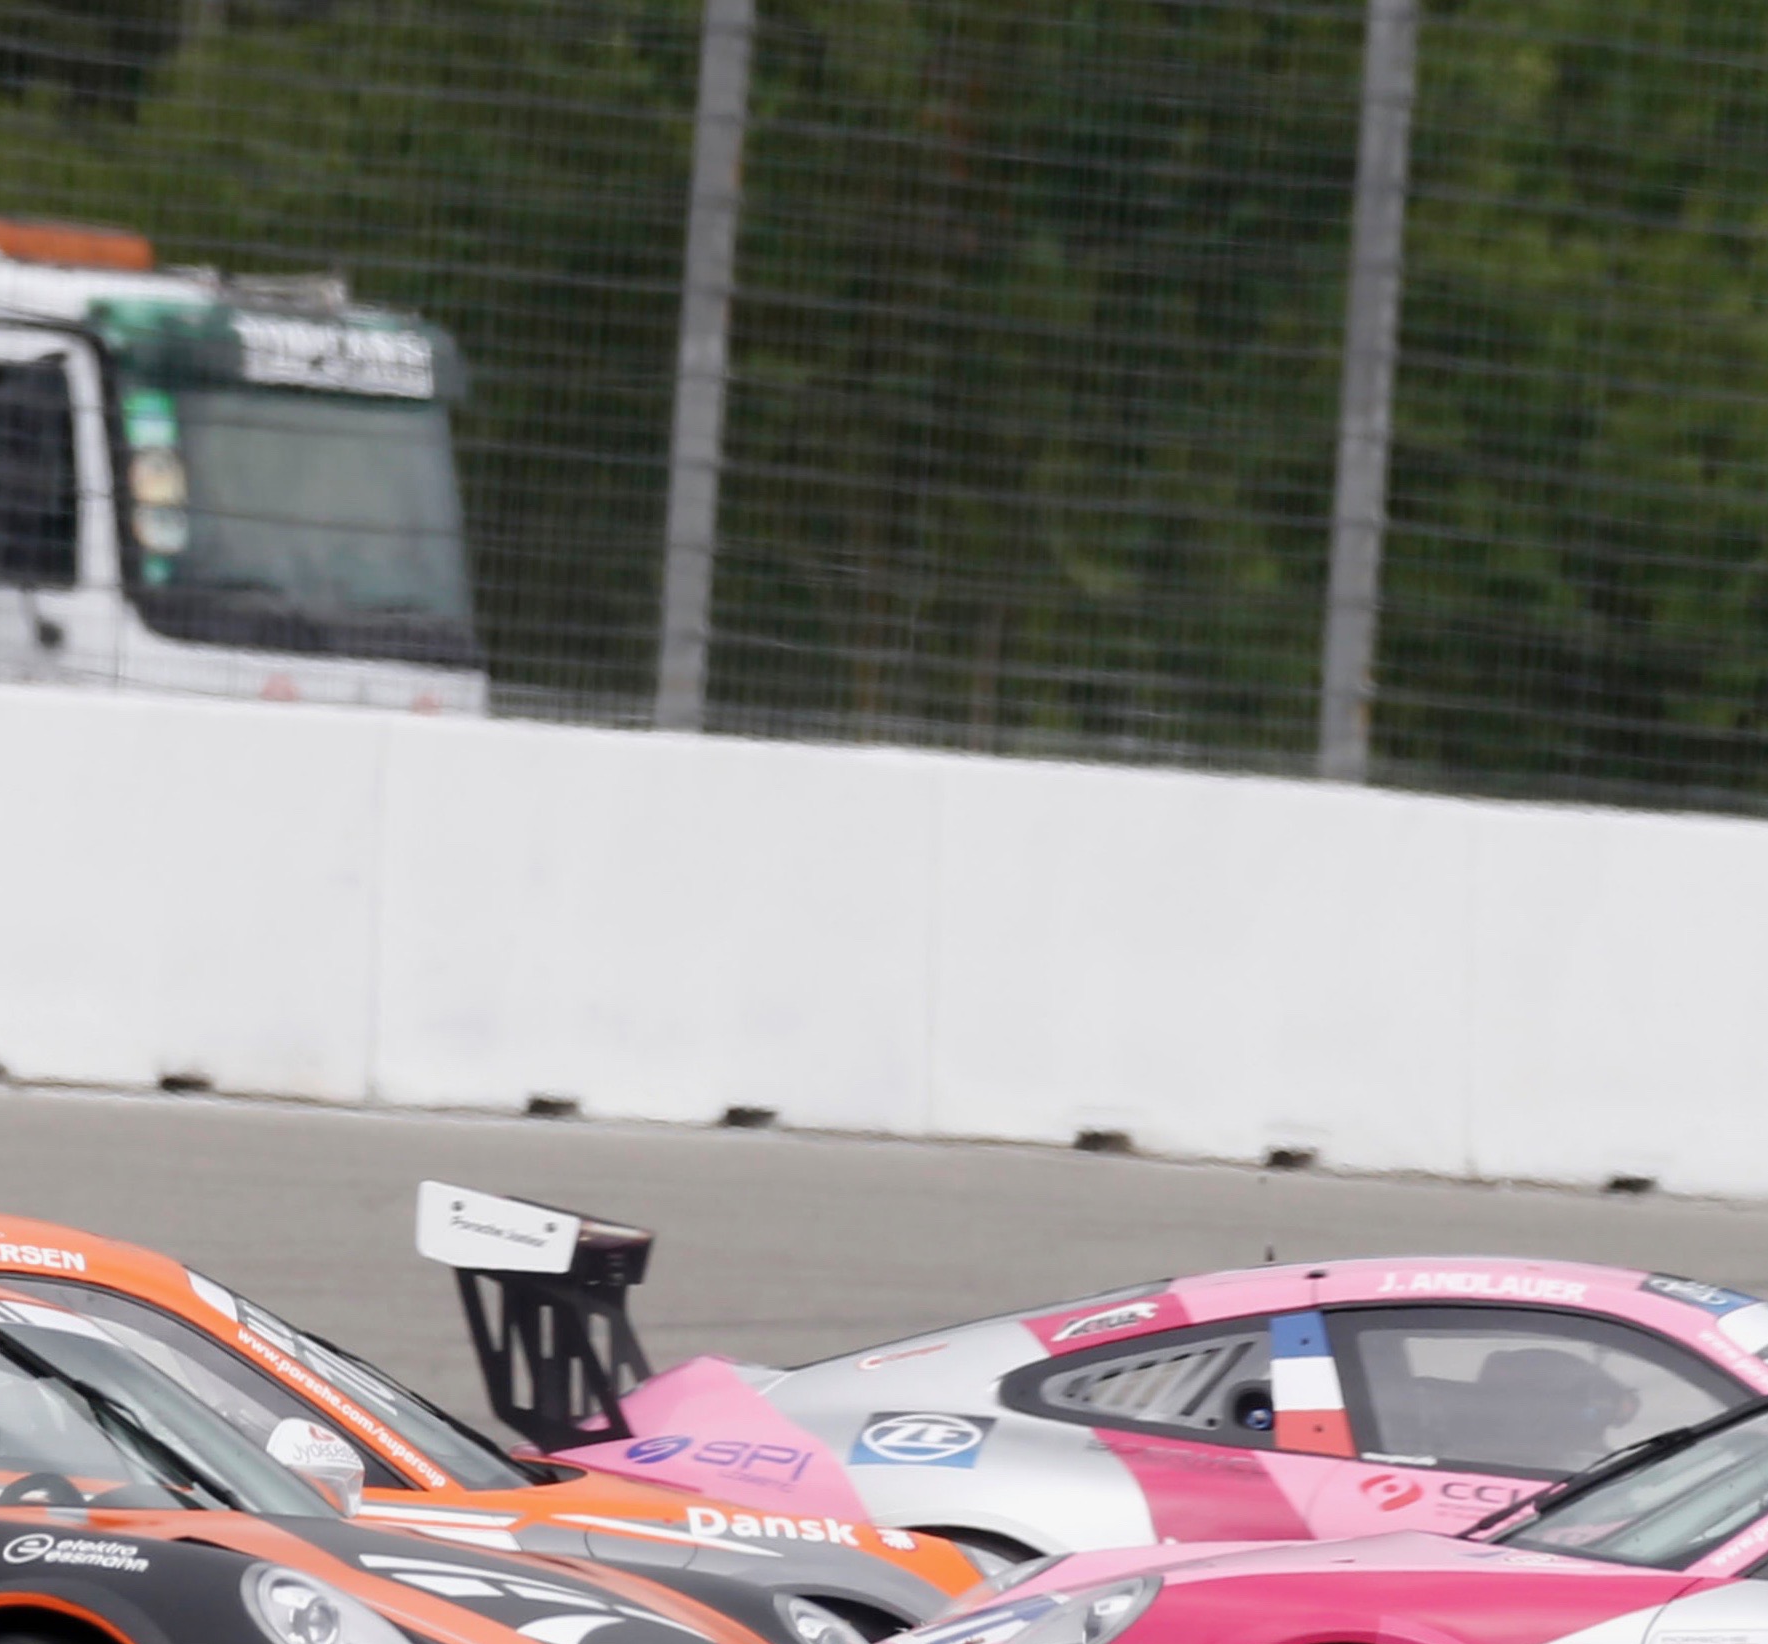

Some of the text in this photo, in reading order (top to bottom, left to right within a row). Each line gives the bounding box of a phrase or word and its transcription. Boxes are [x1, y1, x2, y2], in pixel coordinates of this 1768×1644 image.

[1377, 1271, 1589, 1303] J. ANDLAUER
[237, 1327, 448, 1488] www.porsche.com/supercup
[876, 1421, 961, 1447] ZF
[693, 1439, 815, 1483] SPI
[686, 1505, 860, 1547] Dansk
[44, 1550, 150, 1573] essmann
[56, 1538, 139, 1557] elektro
